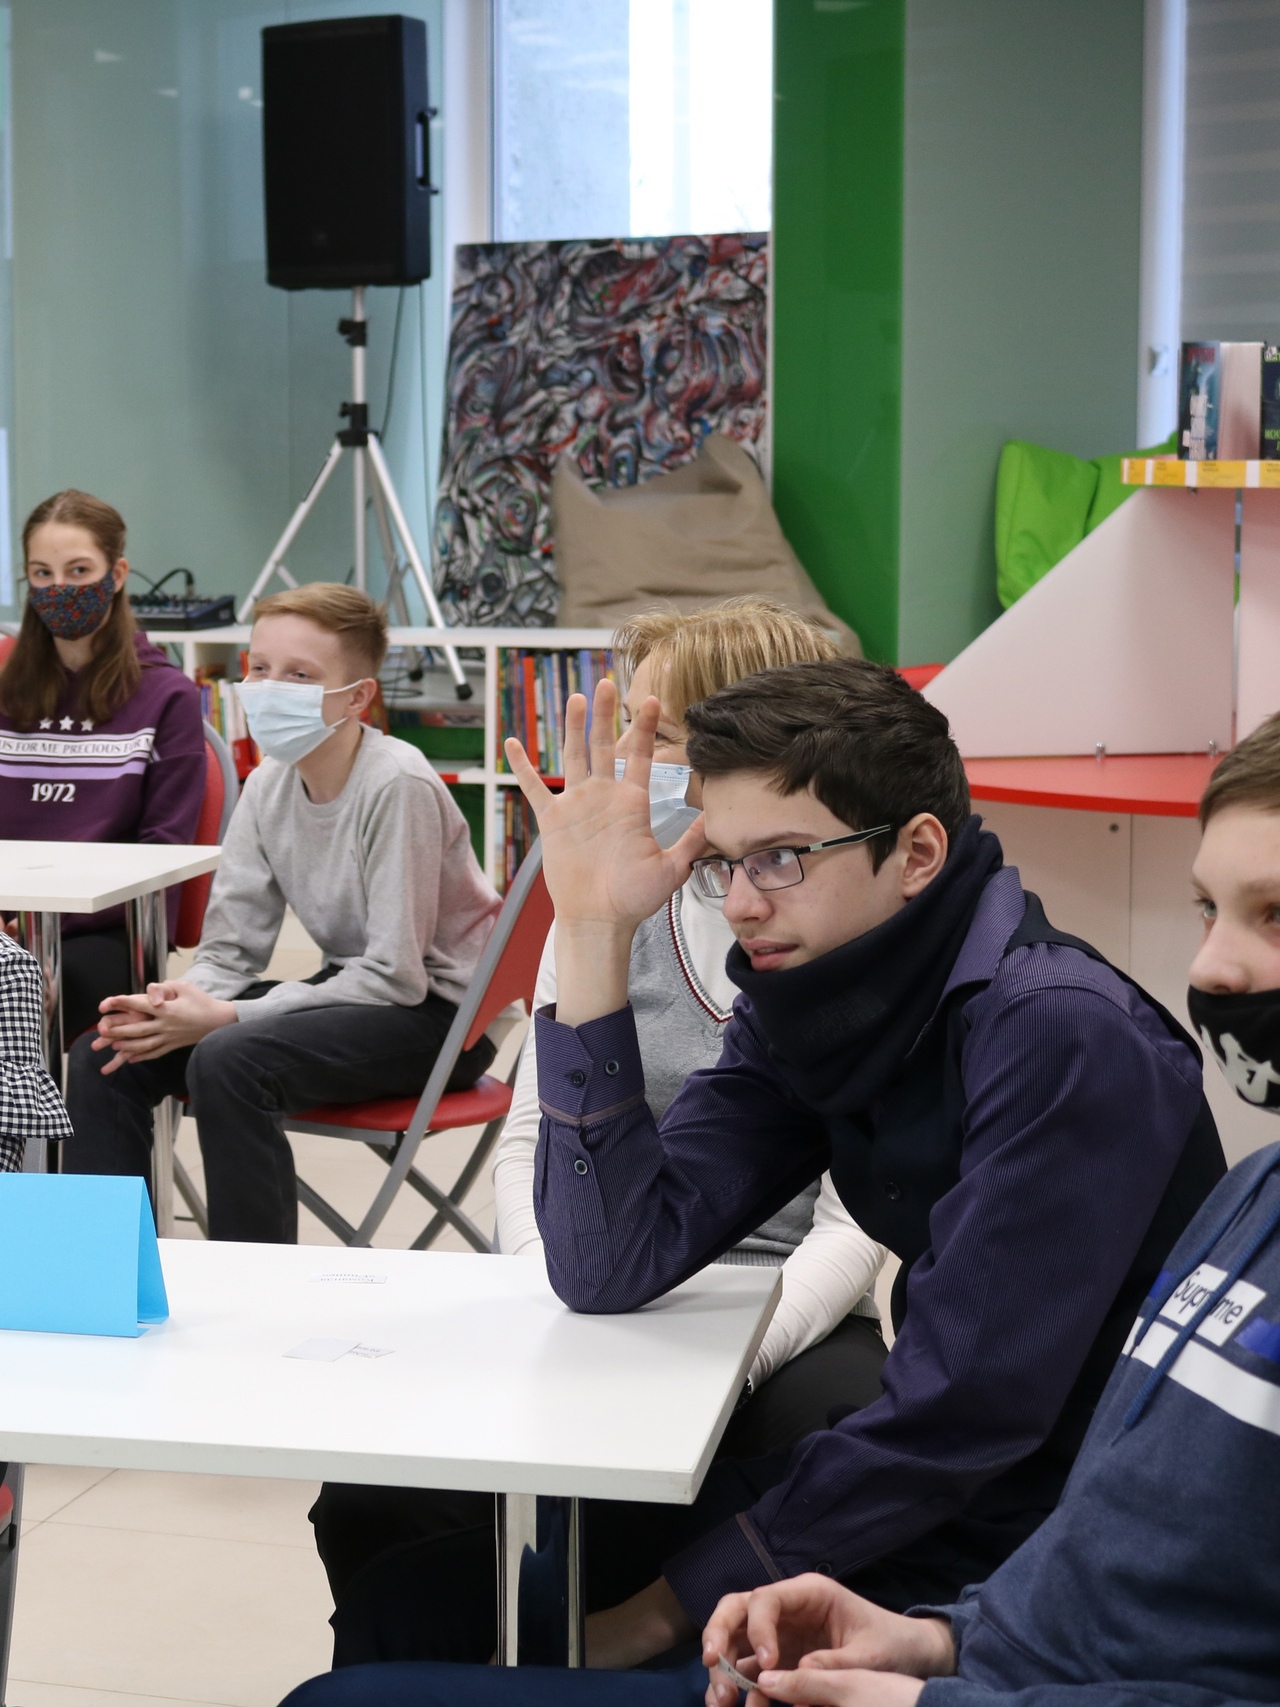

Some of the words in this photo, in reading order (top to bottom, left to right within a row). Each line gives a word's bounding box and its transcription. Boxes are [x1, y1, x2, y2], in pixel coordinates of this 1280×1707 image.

[15, 742, 38, 752] FOR
[62, 743, 120, 754] PRECIOUS
[31, 783, 76, 802] 1972
[1174, 1270, 1244, 1325] Suprme
